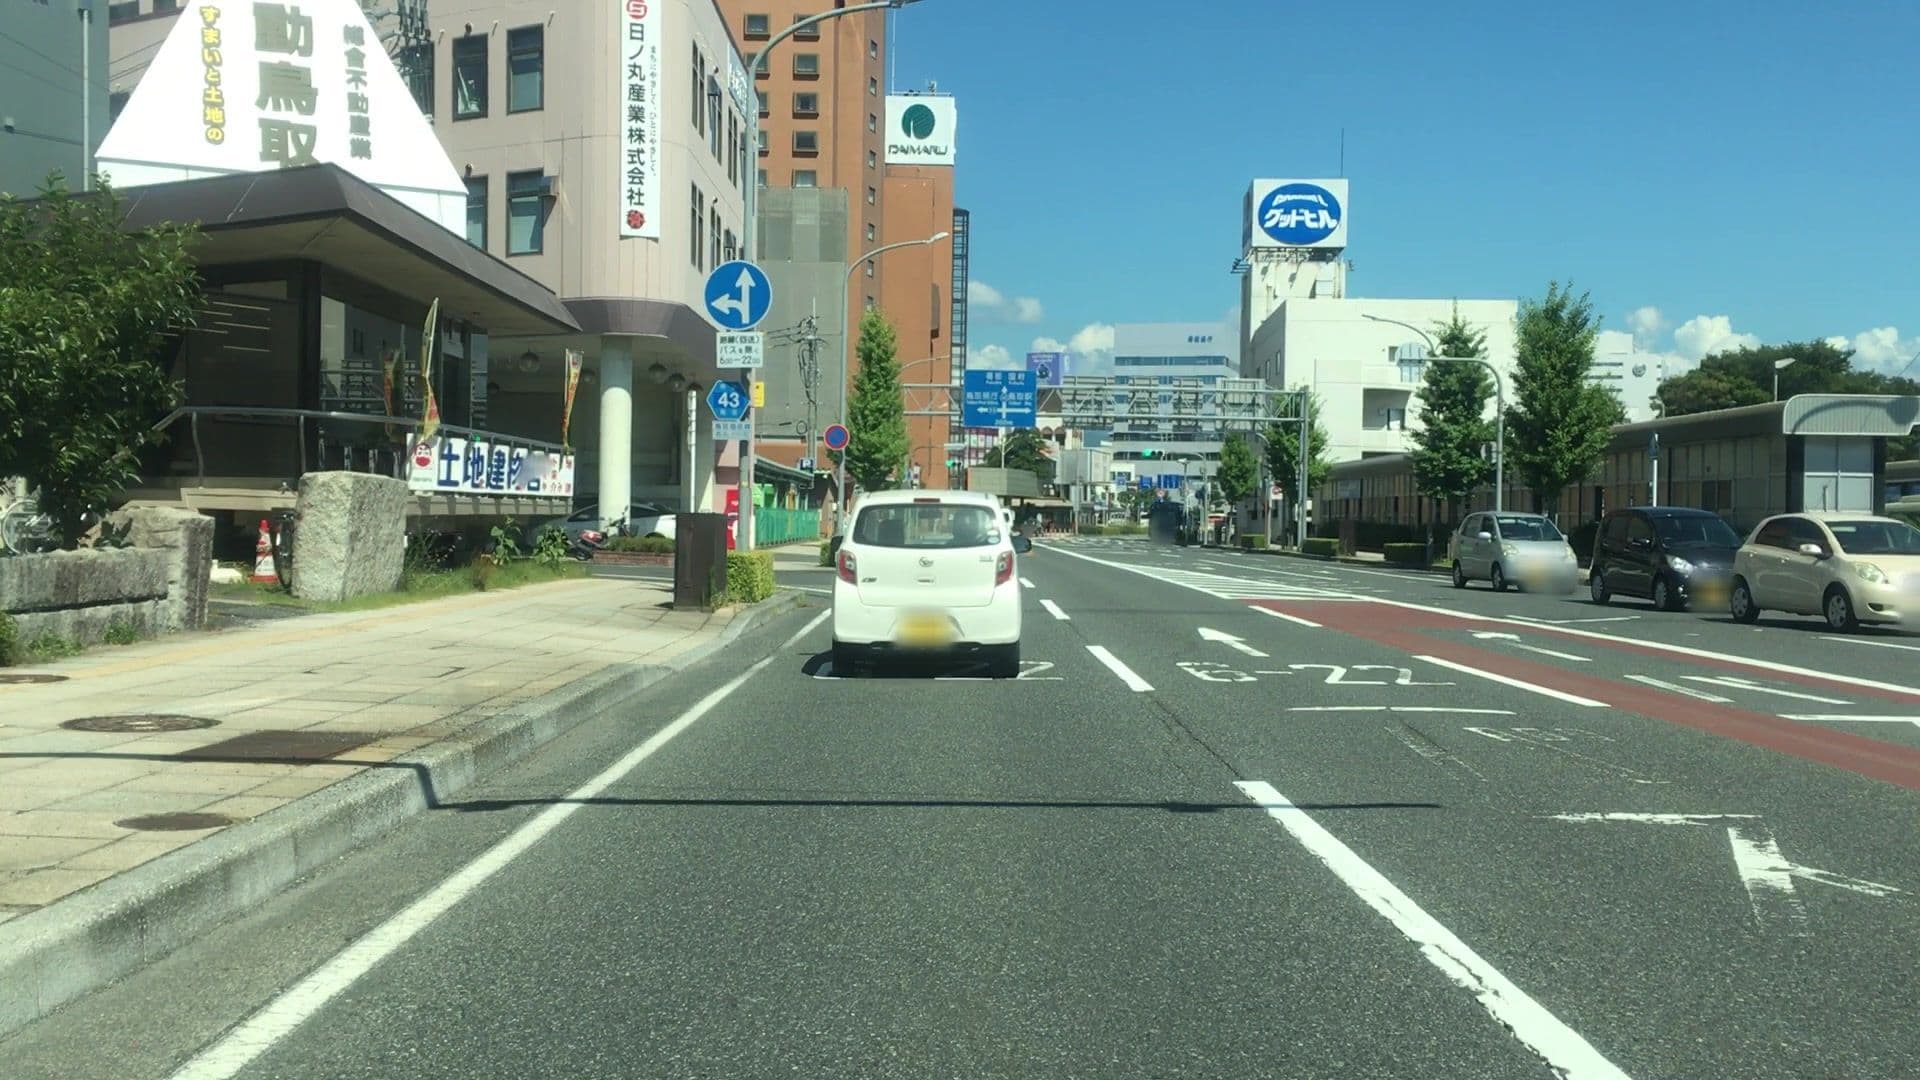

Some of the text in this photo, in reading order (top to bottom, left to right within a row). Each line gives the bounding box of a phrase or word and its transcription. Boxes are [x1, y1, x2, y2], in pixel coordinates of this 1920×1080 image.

[200, 5, 226, 145] すまいと土地の
[627, 22, 646, 206] 日ノ丸産業株式会社
[888, 144, 948, 155] DAIMARU
[718, 392, 740, 408] 43
